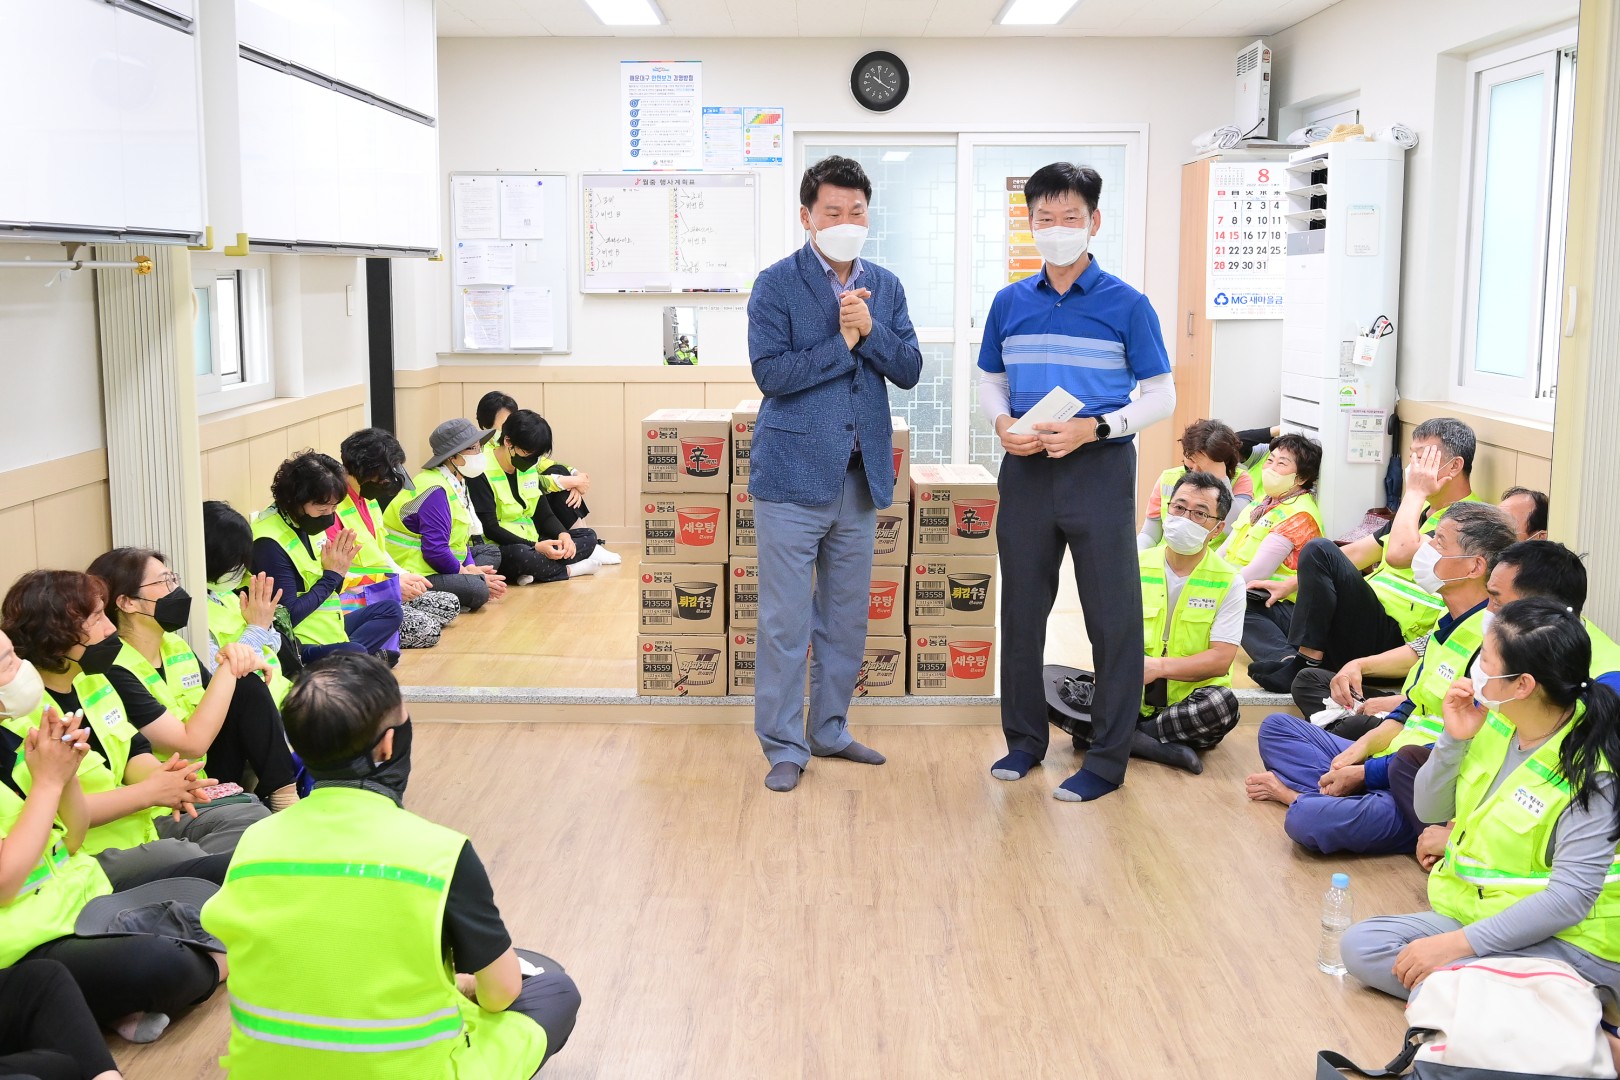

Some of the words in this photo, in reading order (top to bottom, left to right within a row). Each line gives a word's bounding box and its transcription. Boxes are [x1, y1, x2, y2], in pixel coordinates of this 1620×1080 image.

[1258, 168, 1269, 182] 8
[1231, 296, 1248, 304] MG
[1249, 296, 1283, 304] 새마을금
[690, 447, 709, 472] 辛
[962, 508, 980, 534] 辛
[682, 522, 715, 534] 새우탕
[952, 587, 986, 600] 튀김우동
[678, 596, 712, 608] 튀김우동
[680, 661, 717, 673] 짜파게티
[954, 656, 986, 666] 새우탕
